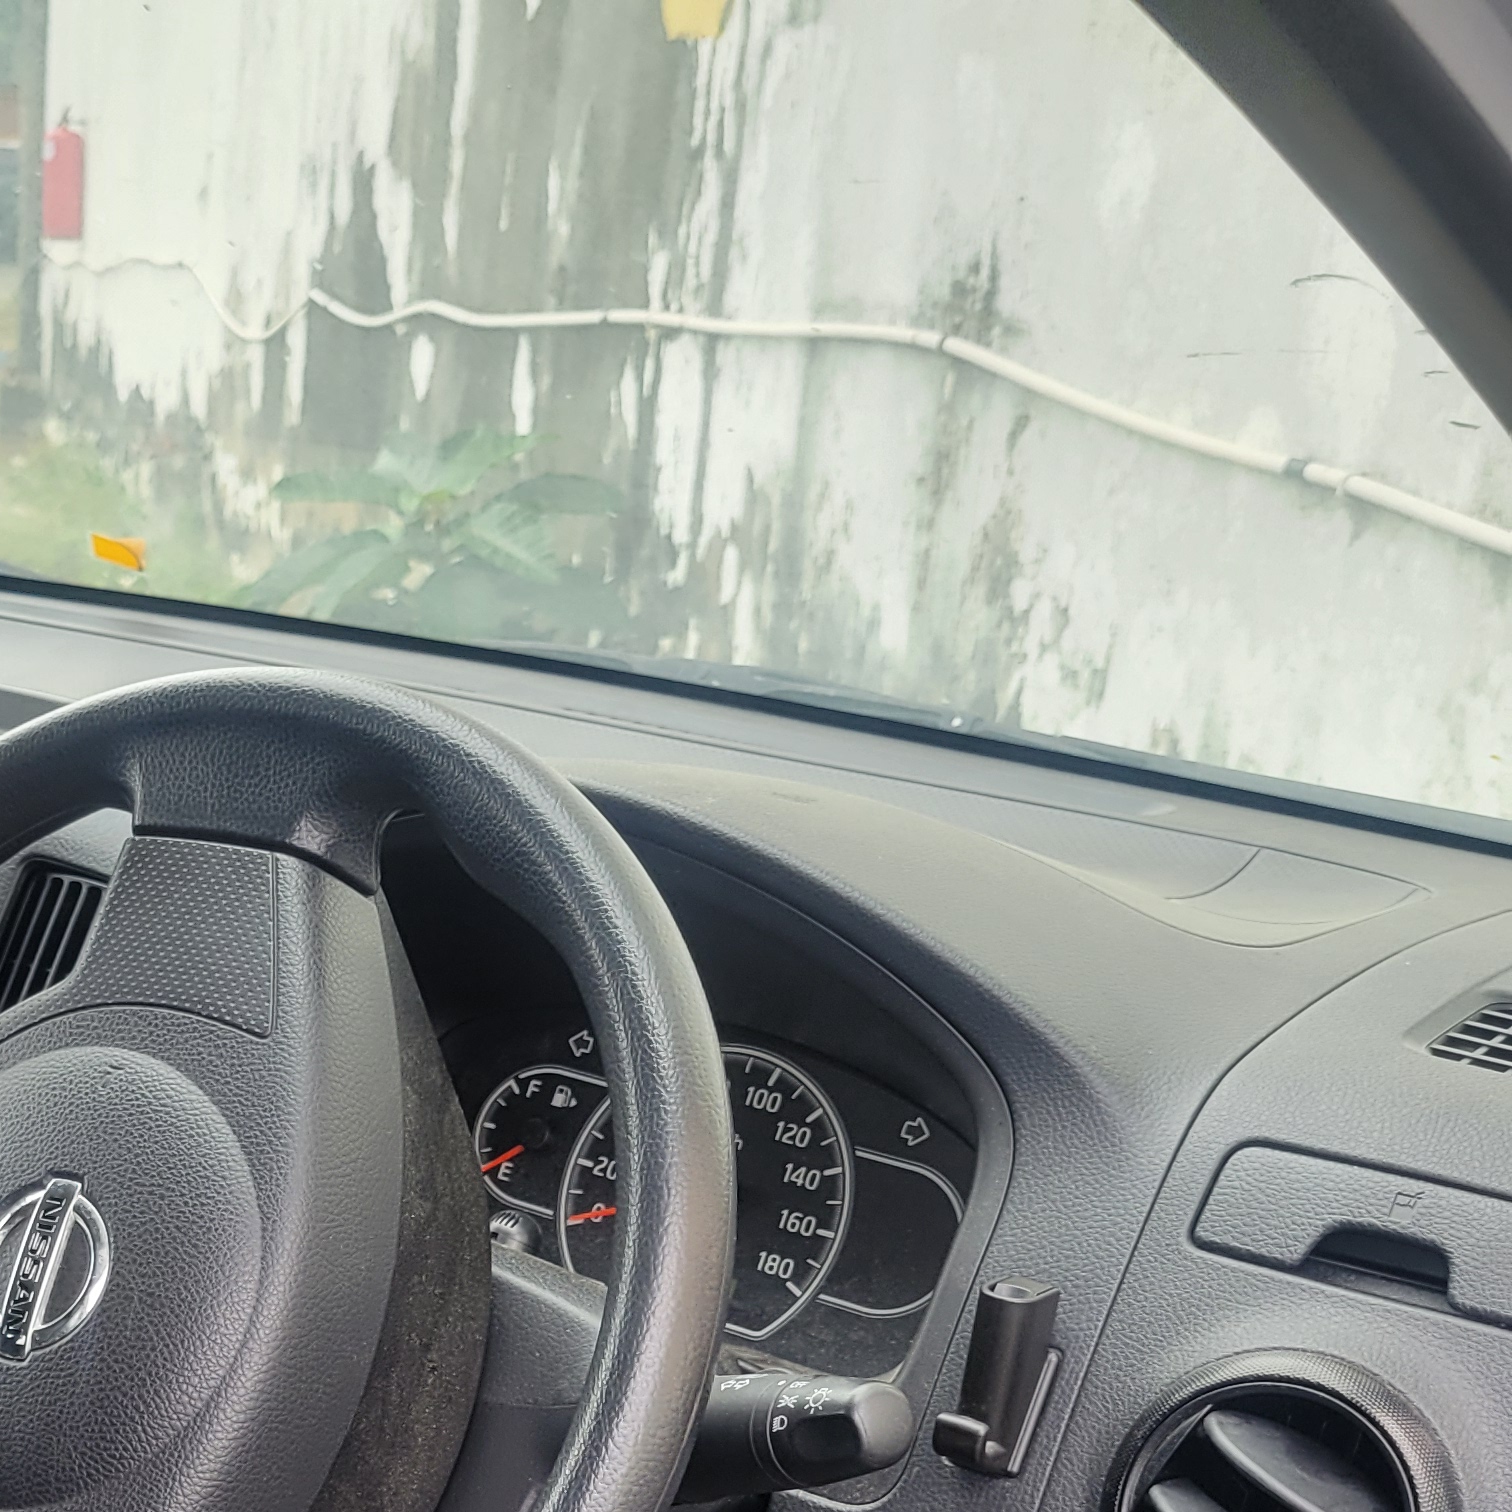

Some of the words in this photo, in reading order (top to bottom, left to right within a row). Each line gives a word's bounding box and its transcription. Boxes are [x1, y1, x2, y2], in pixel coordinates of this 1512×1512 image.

[525, 1079, 543, 1098] F
[744, 1086, 783, 1113] 100
[774, 1121, 812, 1148] 120
[497, 1161, 515, 1182] E
[592, 1156, 617, 1181] 20
[783, 1163, 822, 1191] 140
[778, 1209, 818, 1237] 160
[2, 1196, 67, 1346] NISSAN
[756, 1250, 795, 1279] 180
